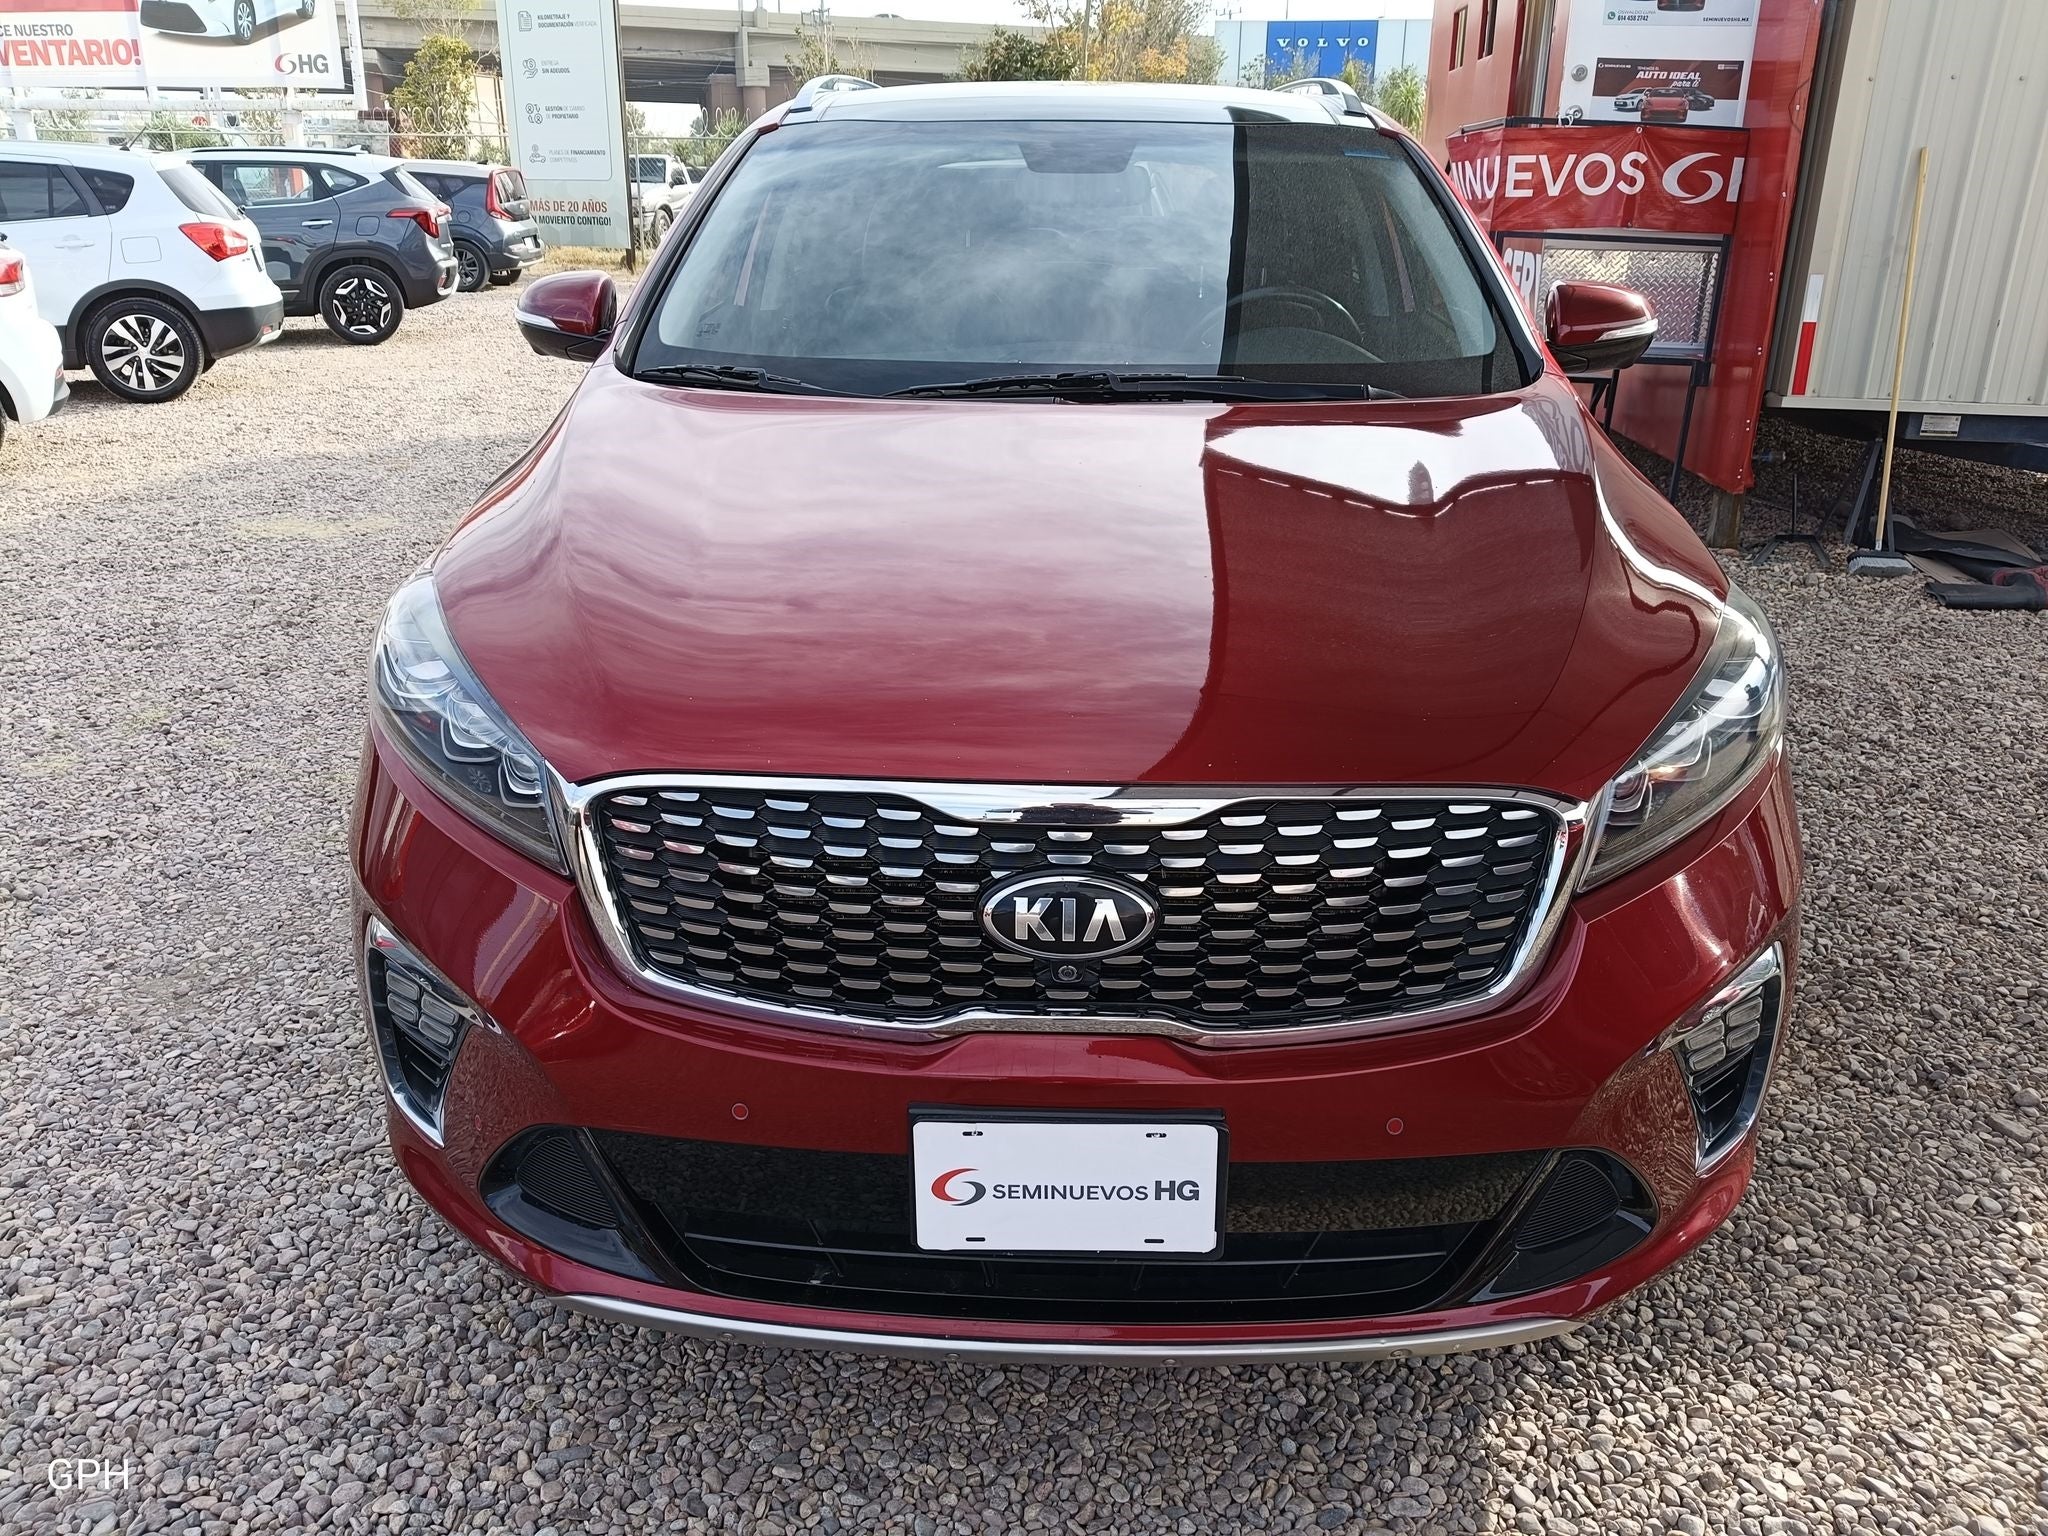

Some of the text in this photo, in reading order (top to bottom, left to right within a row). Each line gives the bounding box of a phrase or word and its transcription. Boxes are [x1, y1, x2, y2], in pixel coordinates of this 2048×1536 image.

[14, 24, 73, 36] NUESTRO
[1277, 37, 1369, 47] VOLVO
[298, 54, 329, 73] HG
[1636, 71, 1701, 80] AUTO IDEAL
[529, 197, 608, 213] MÁS DE 20 AÑOS
[538, 216, 576, 225] MOVIENTO
[577, 216, 612, 226] CONTIGO!
[1013, 897, 1126, 942] KIA
[992, 1180, 1200, 1201] SEMINUEVOS HG
